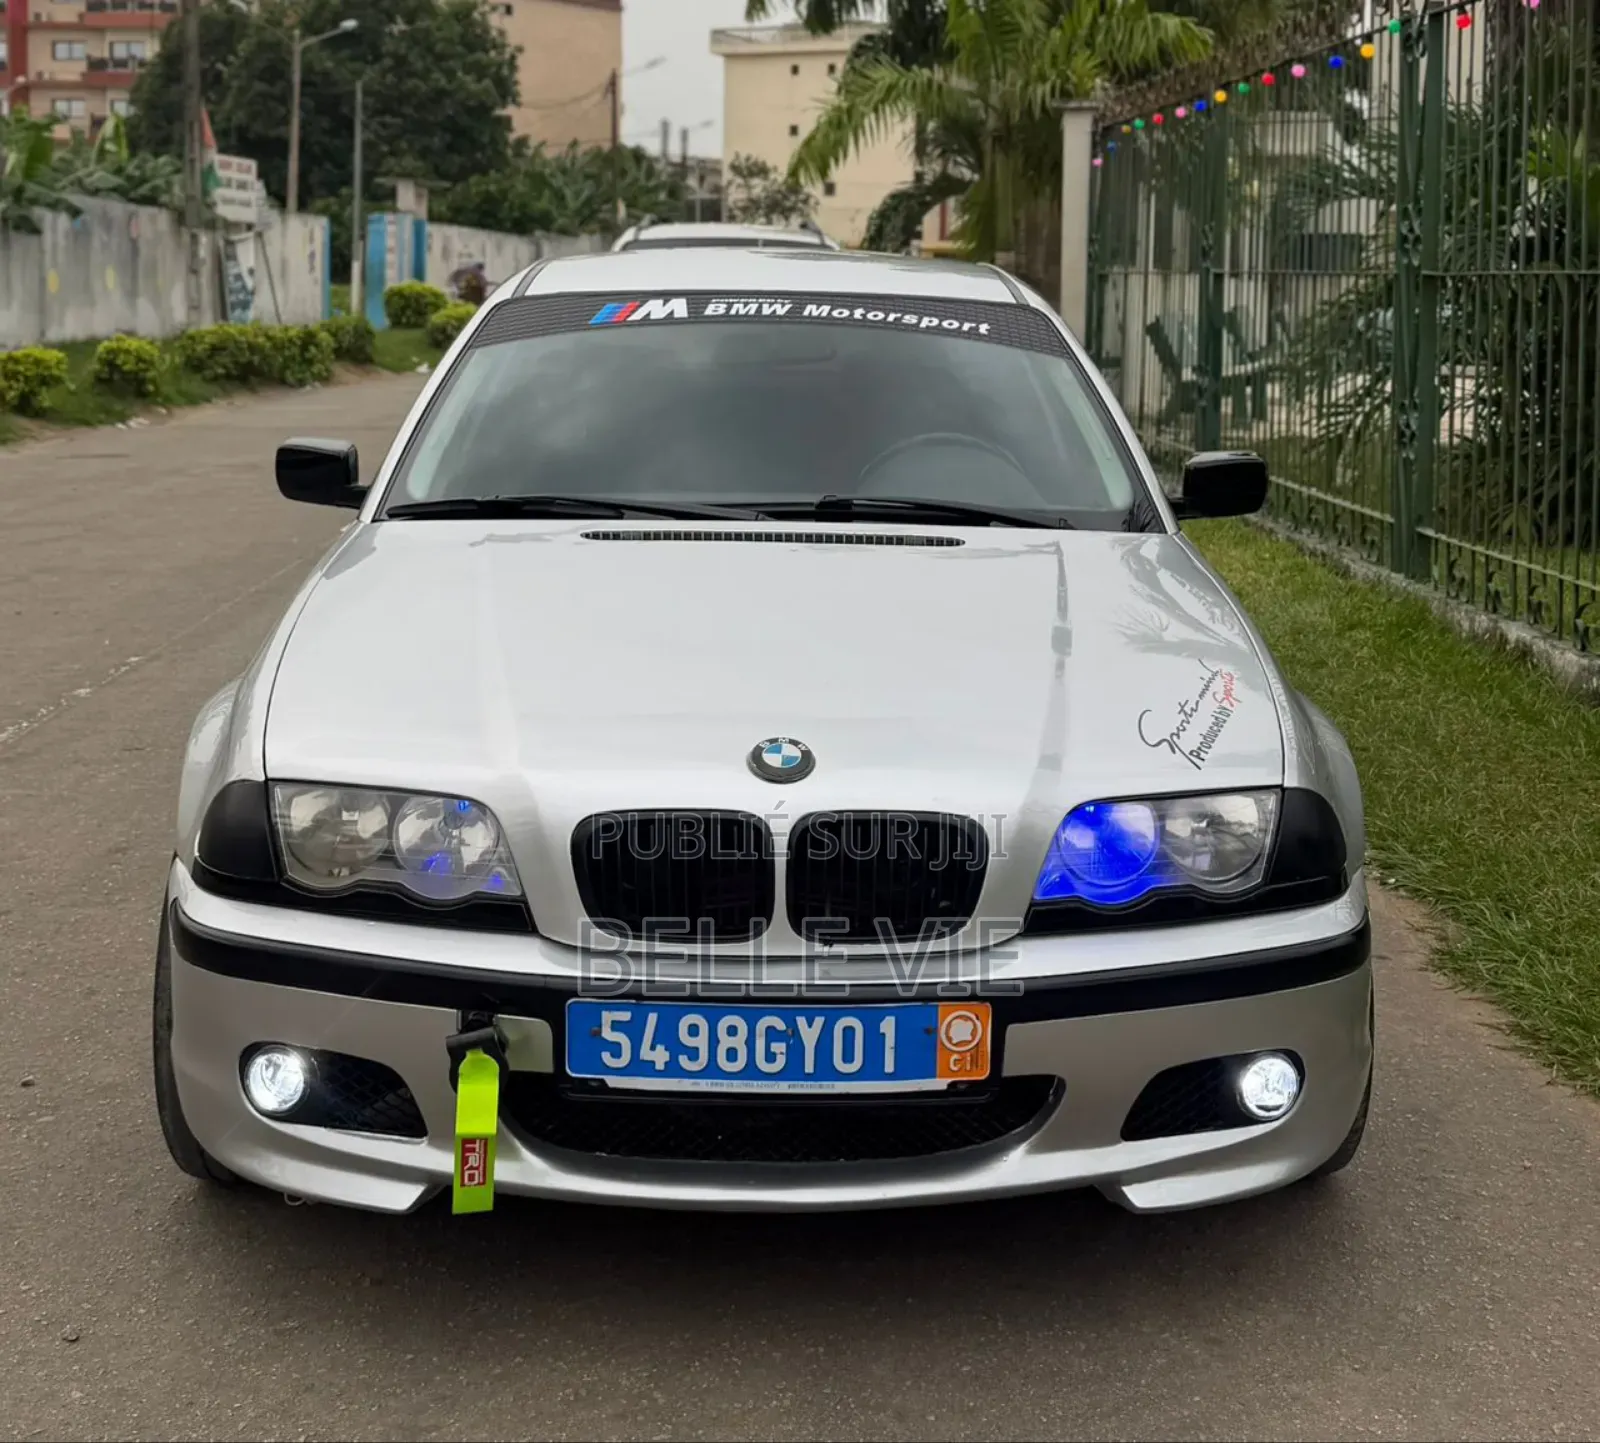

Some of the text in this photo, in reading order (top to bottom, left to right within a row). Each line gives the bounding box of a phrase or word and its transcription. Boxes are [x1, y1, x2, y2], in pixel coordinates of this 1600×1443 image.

[704, 303, 794, 316] BMW
[803, 304, 991, 335] Motorsport
[600, 1010, 897, 1074] 5498GY01
[464, 1139, 480, 1186] TRD
